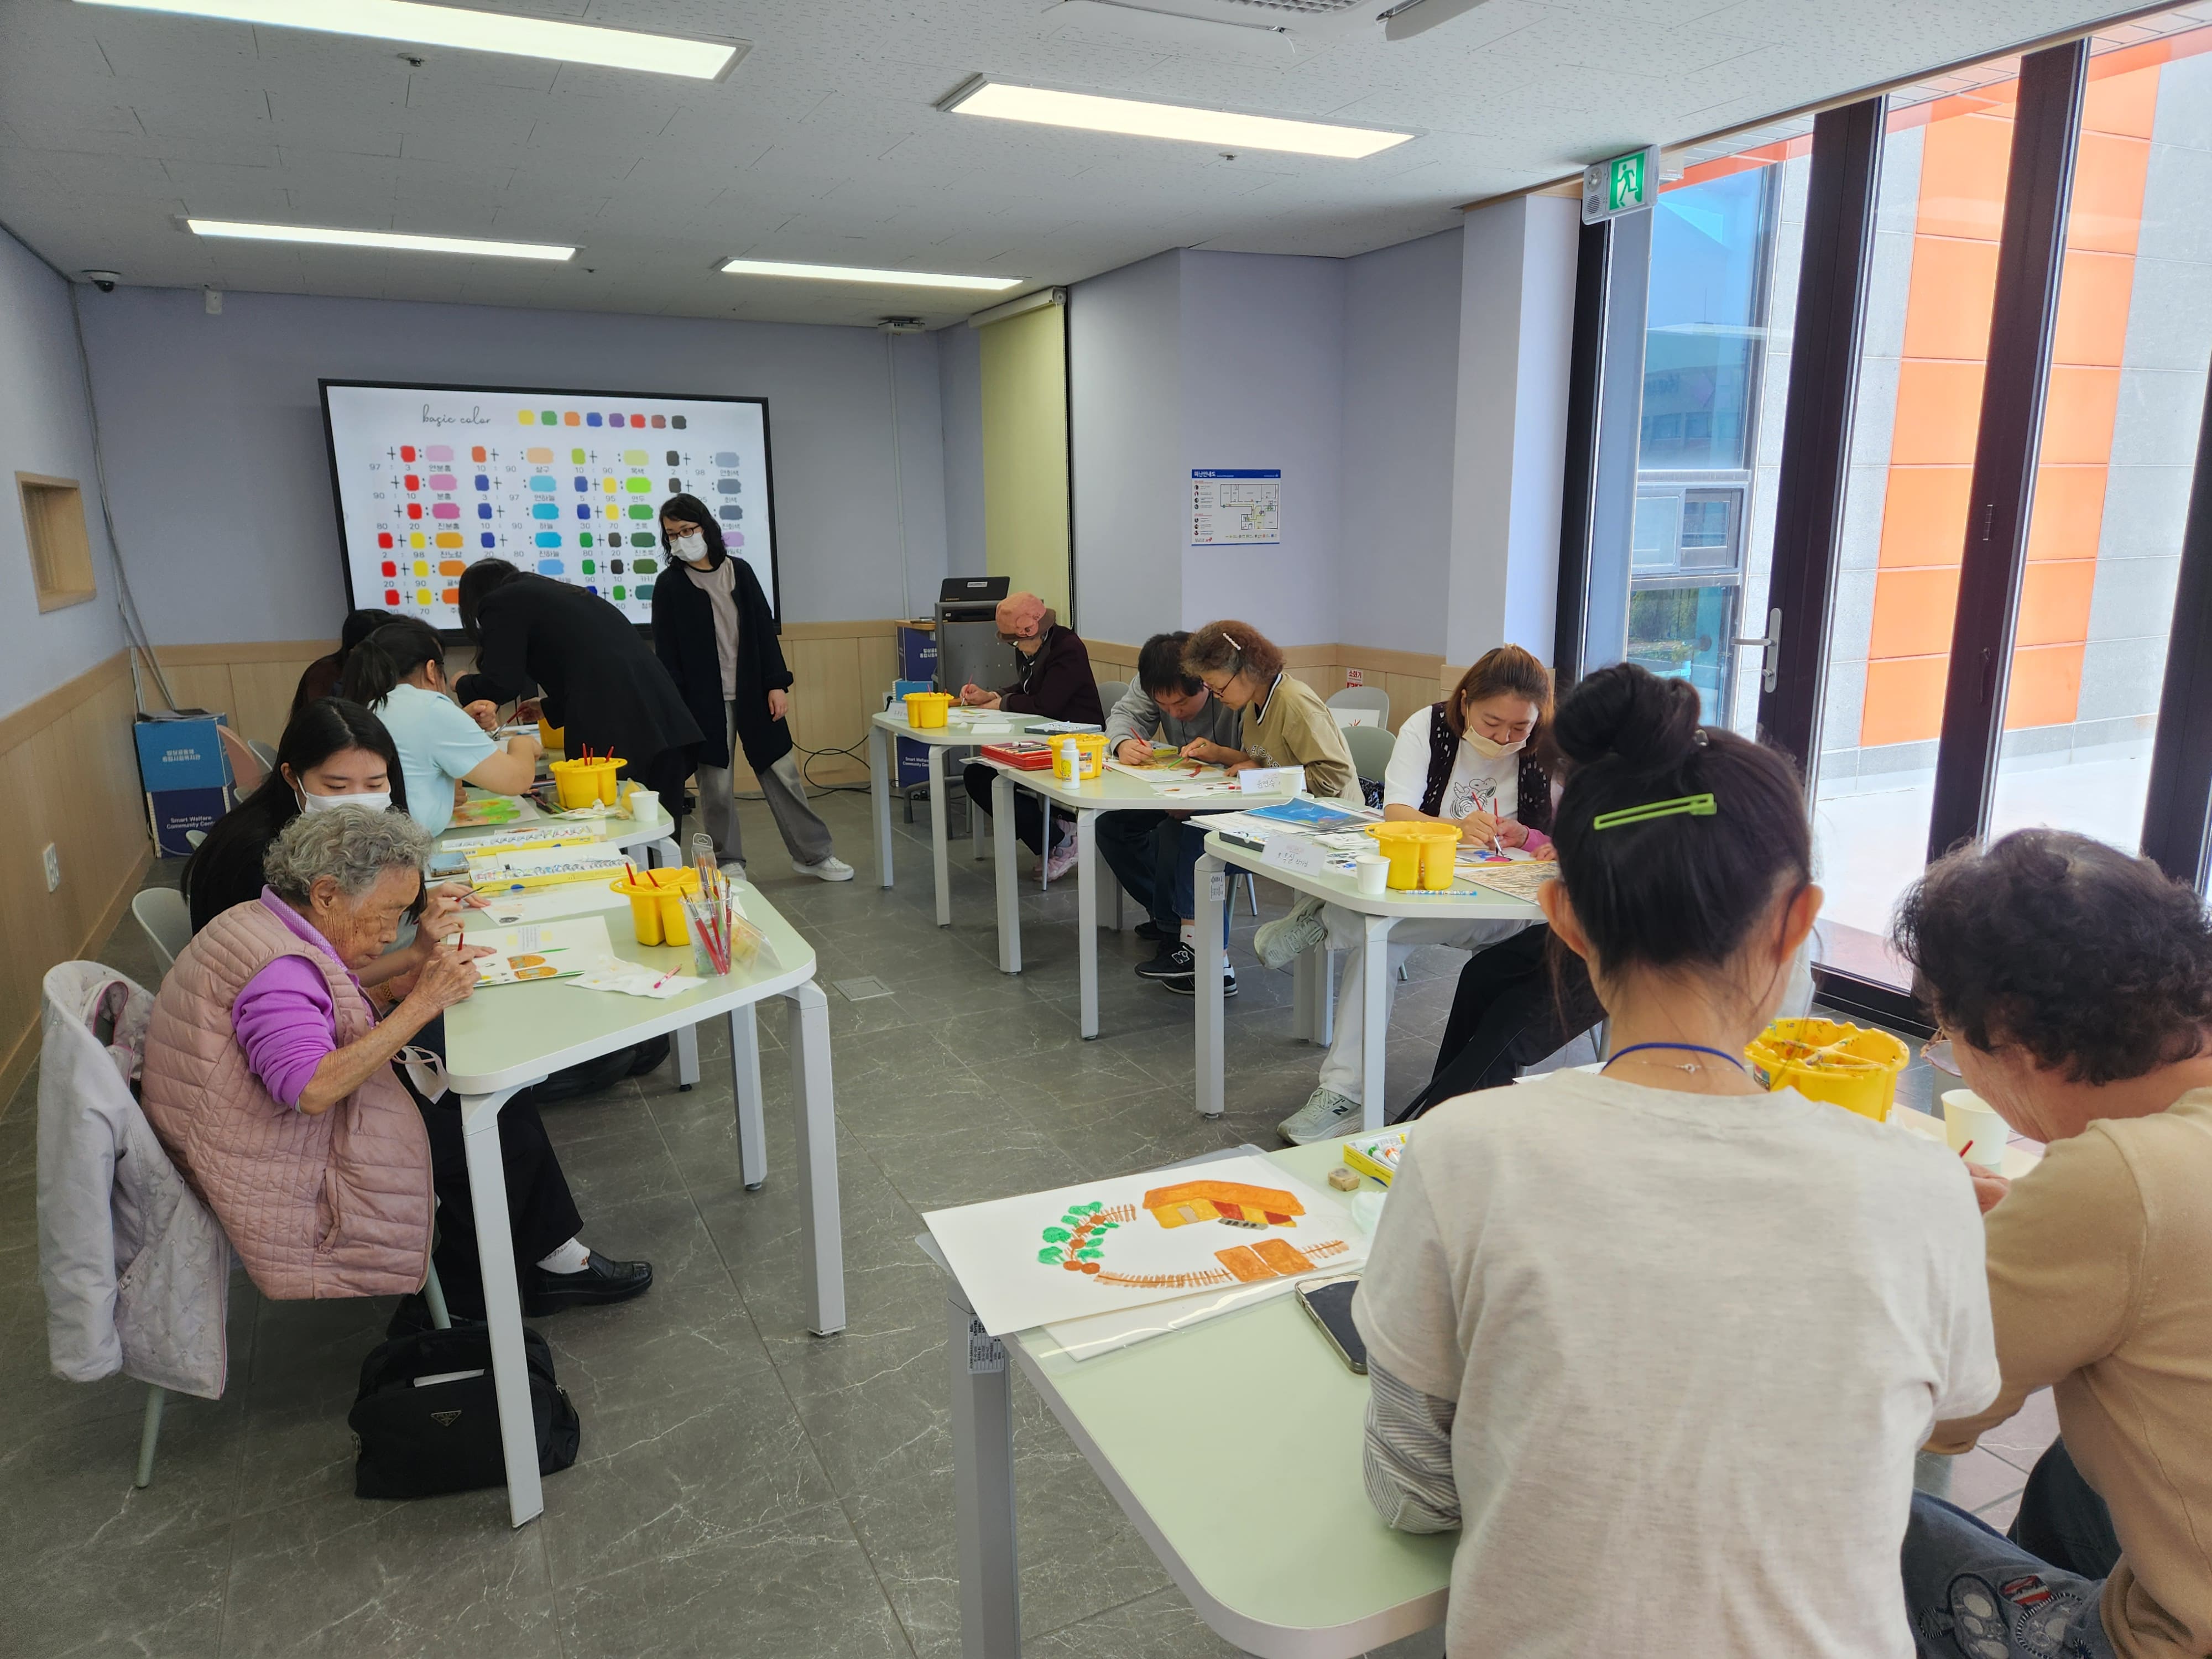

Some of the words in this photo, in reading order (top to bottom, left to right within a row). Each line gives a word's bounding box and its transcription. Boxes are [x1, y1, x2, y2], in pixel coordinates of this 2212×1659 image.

[422, 404, 455, 427] basic
[460, 406, 491, 424] color
[1348, 670, 1362, 679] 소화기
